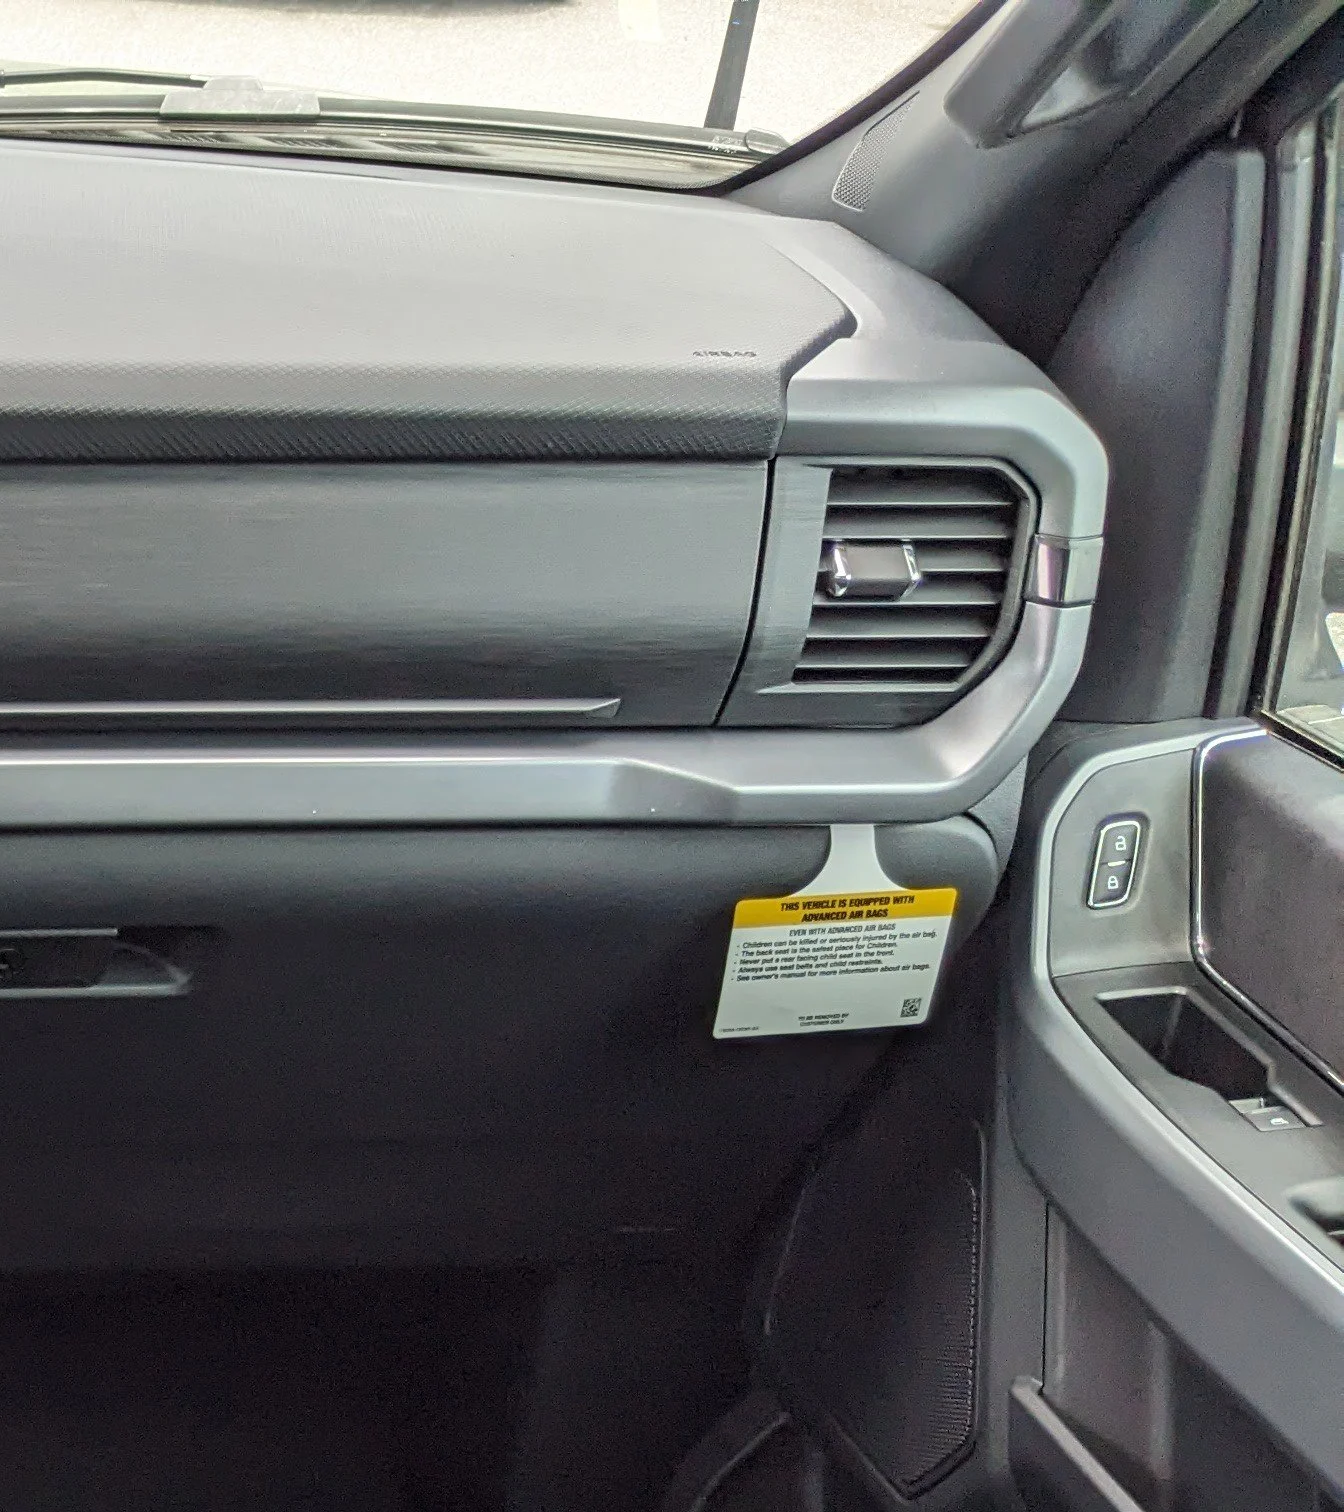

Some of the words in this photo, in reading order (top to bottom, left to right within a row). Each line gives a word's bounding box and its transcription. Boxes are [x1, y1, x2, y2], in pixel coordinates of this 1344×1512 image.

[781, 902, 799, 911] THIS
[802, 899, 836, 910] VEHICLE
[838, 899, 847, 907] IS
[849, 897, 890, 907] EQUIPPED
[893, 895, 915, 905] WITH
[802, 912, 846, 922] ADVANCED
[848, 910, 863, 919] AIR
[866, 909, 888, 917] BAGS
[828, 926, 862, 934] ADVANCED
[863, 934, 887, 942] injured
